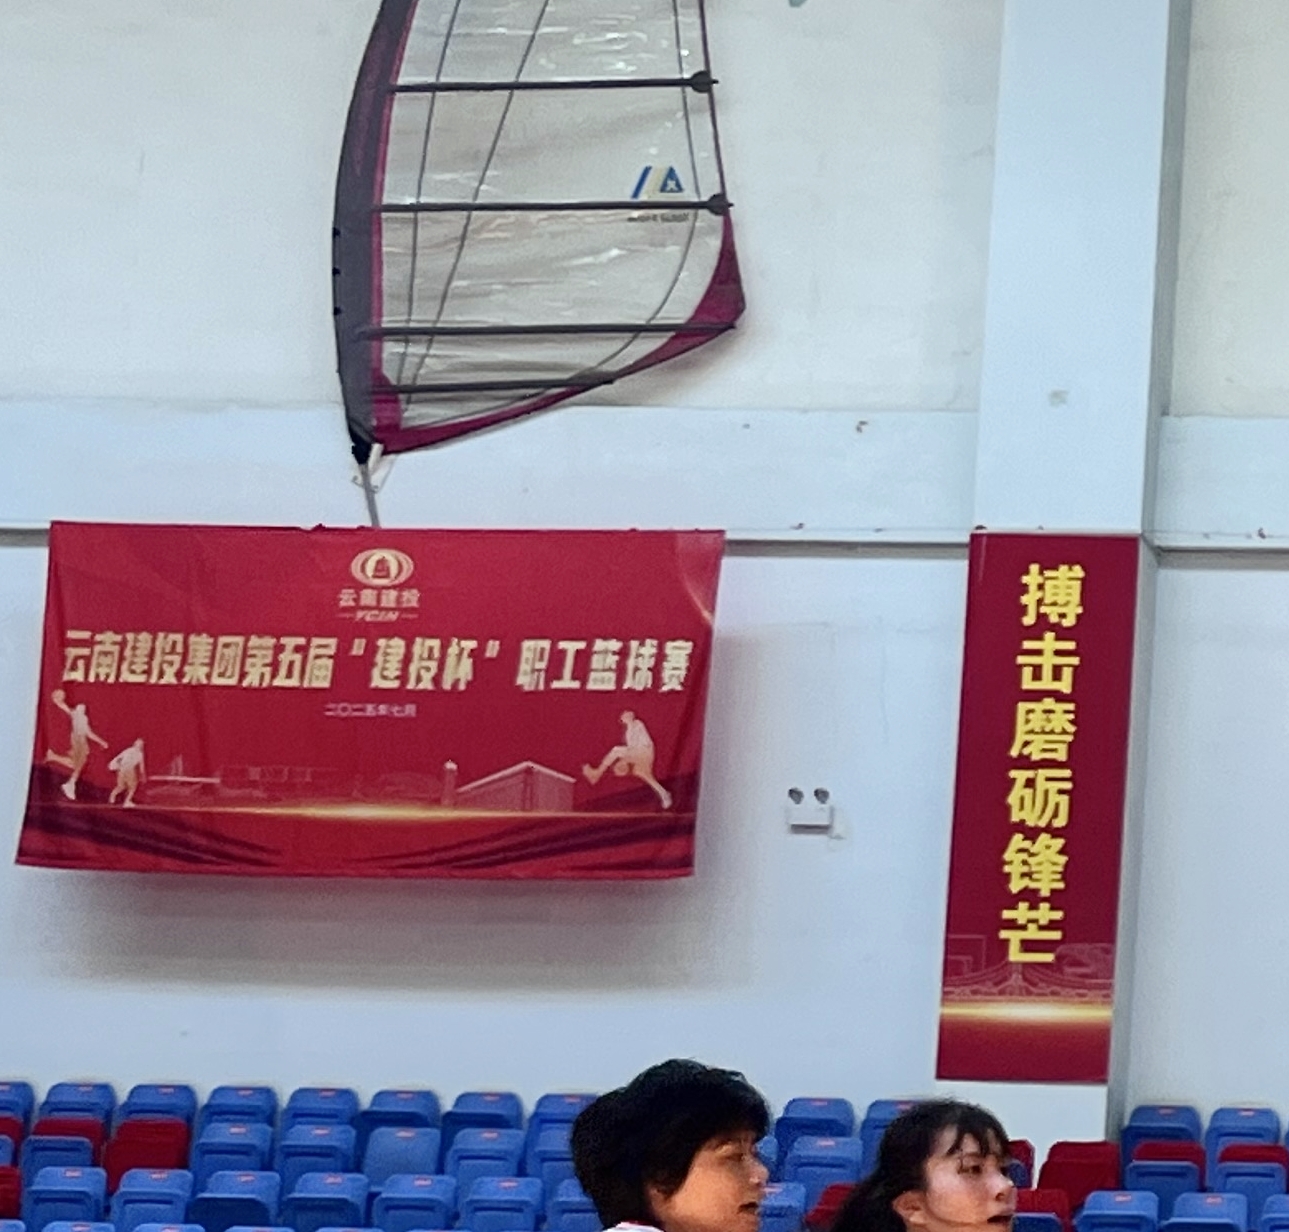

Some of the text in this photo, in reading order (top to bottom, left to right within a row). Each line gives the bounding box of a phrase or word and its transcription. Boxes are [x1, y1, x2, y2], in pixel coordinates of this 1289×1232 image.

[999, 563, 1086, 964] 搏击磨砺锋芒
